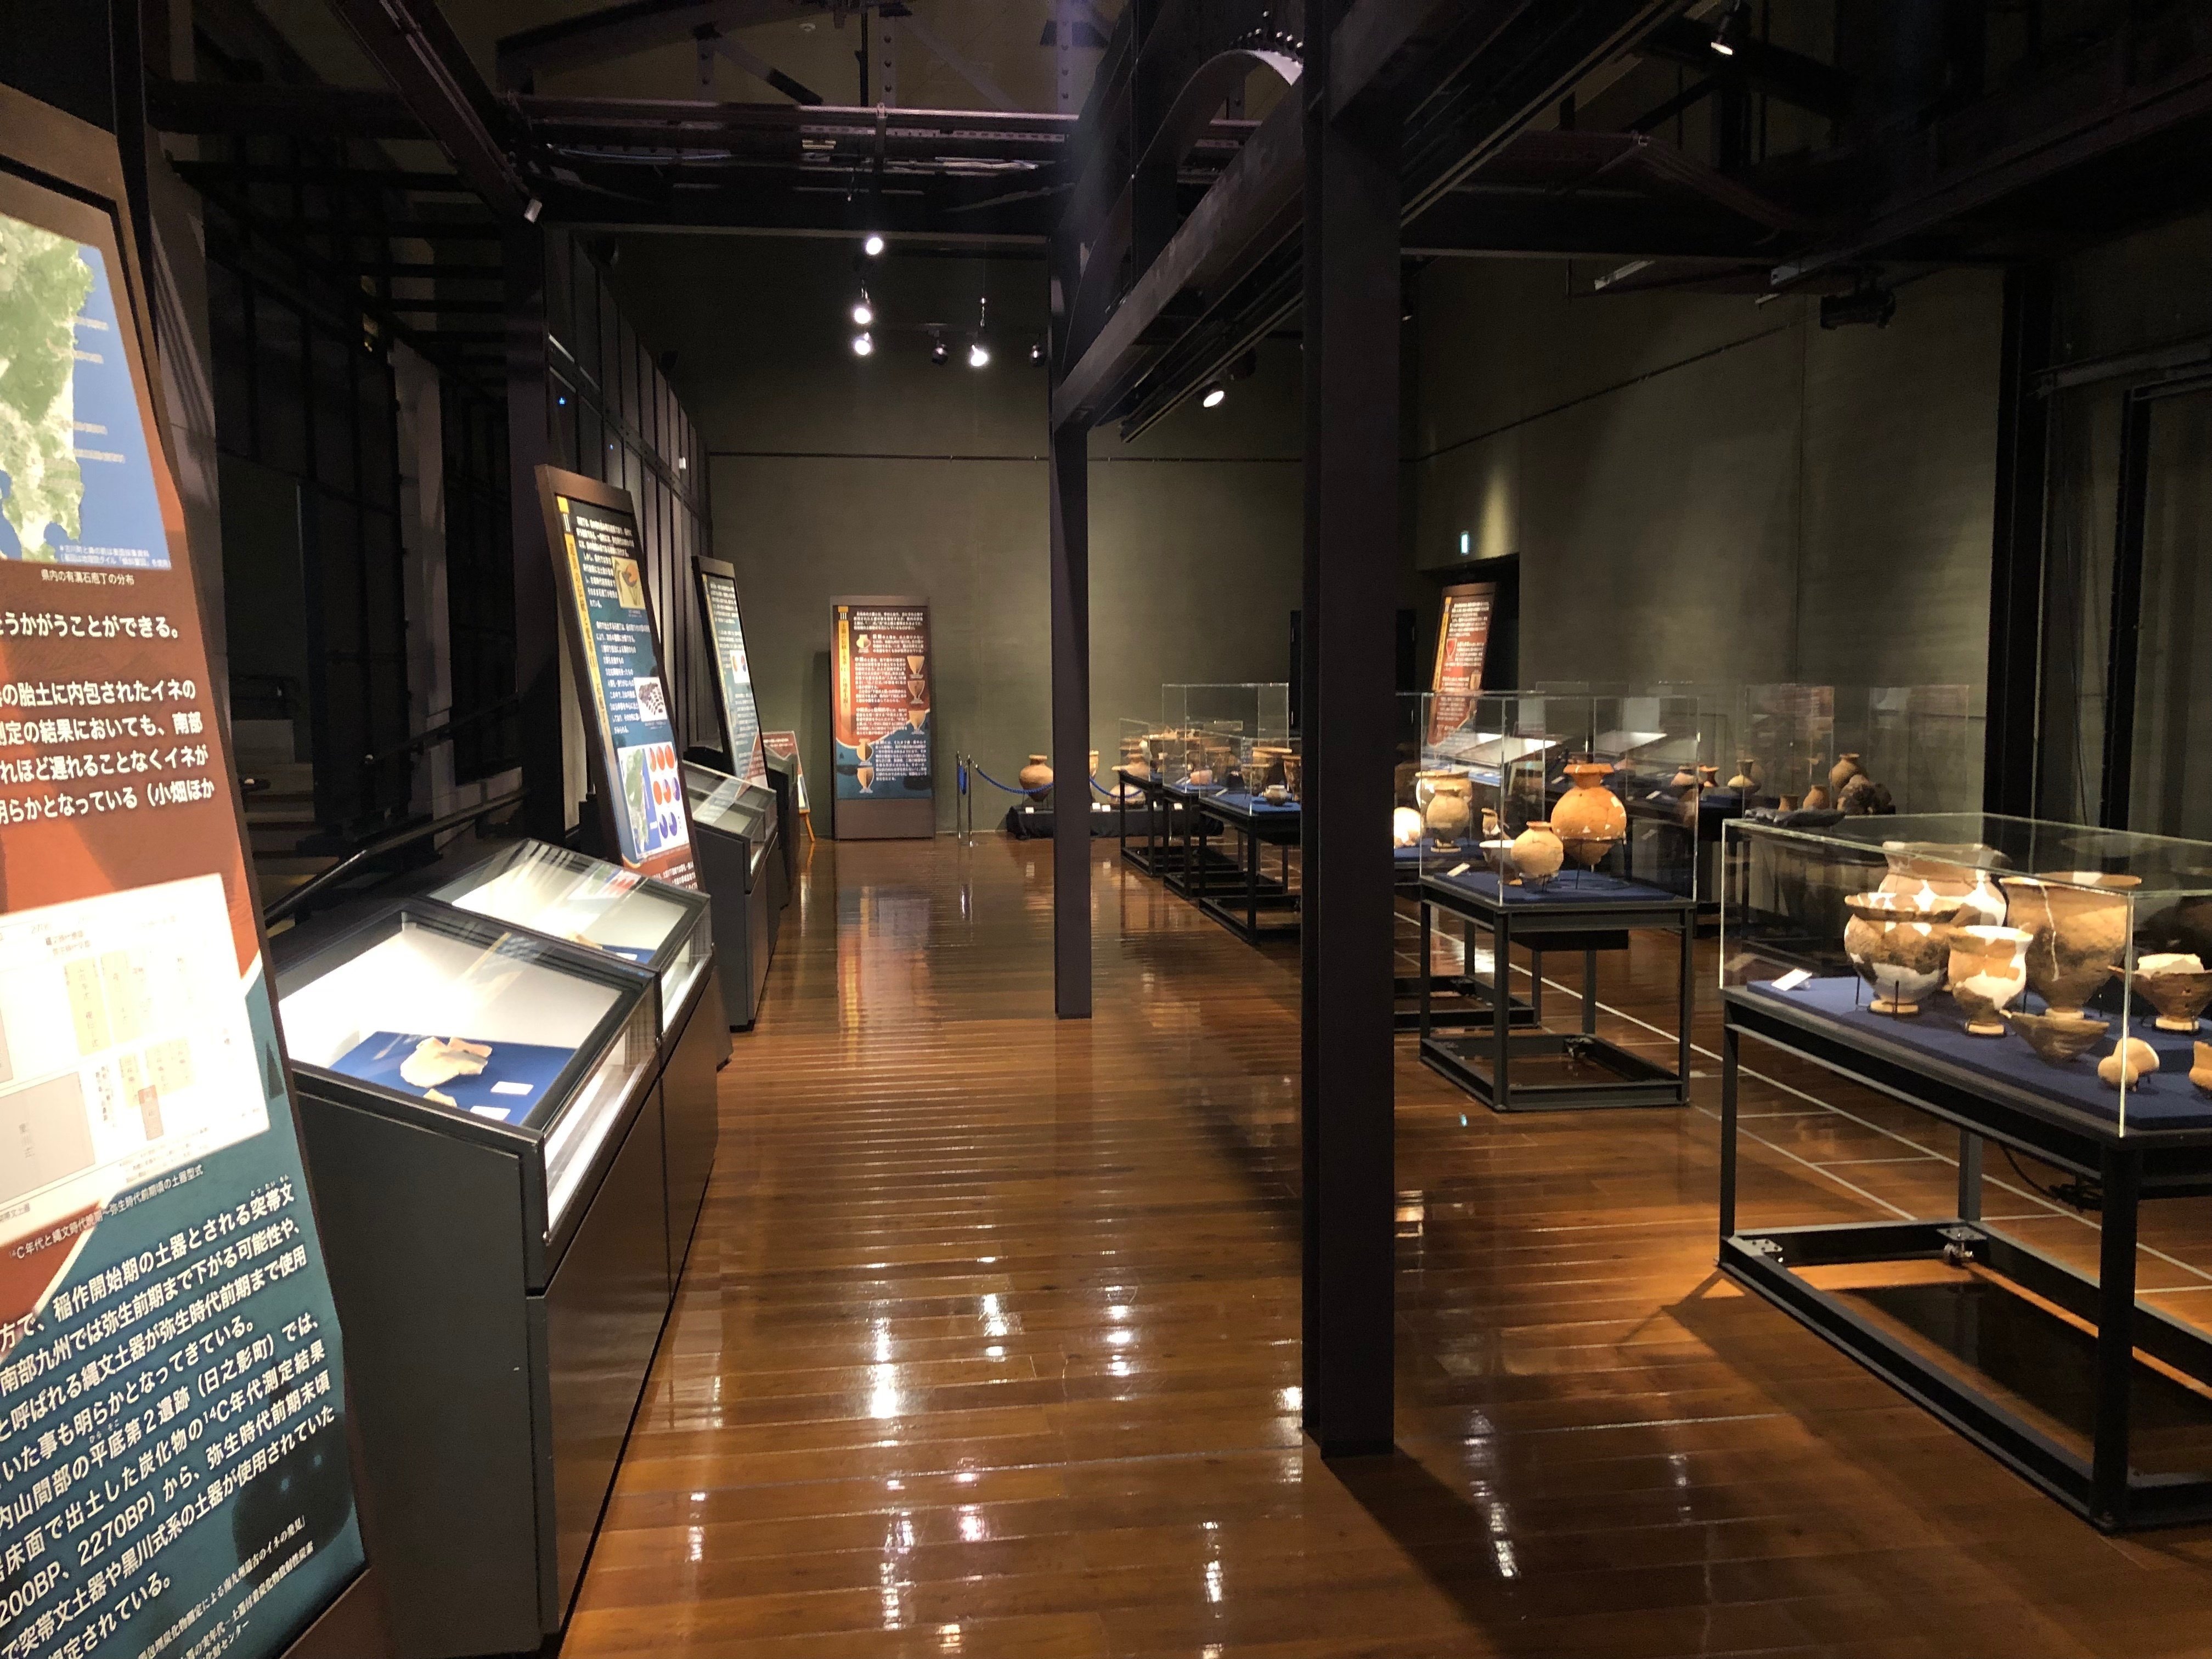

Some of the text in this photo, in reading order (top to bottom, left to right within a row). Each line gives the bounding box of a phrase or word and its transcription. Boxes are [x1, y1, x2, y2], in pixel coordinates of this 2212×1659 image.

[0, 612, 178, 639] うかがうことができる。
[0, 679, 195, 707] の胎土に内包されたイネの
[0, 1339, 325, 1583] 床面で出土した炭化物の14C年代測定結果
